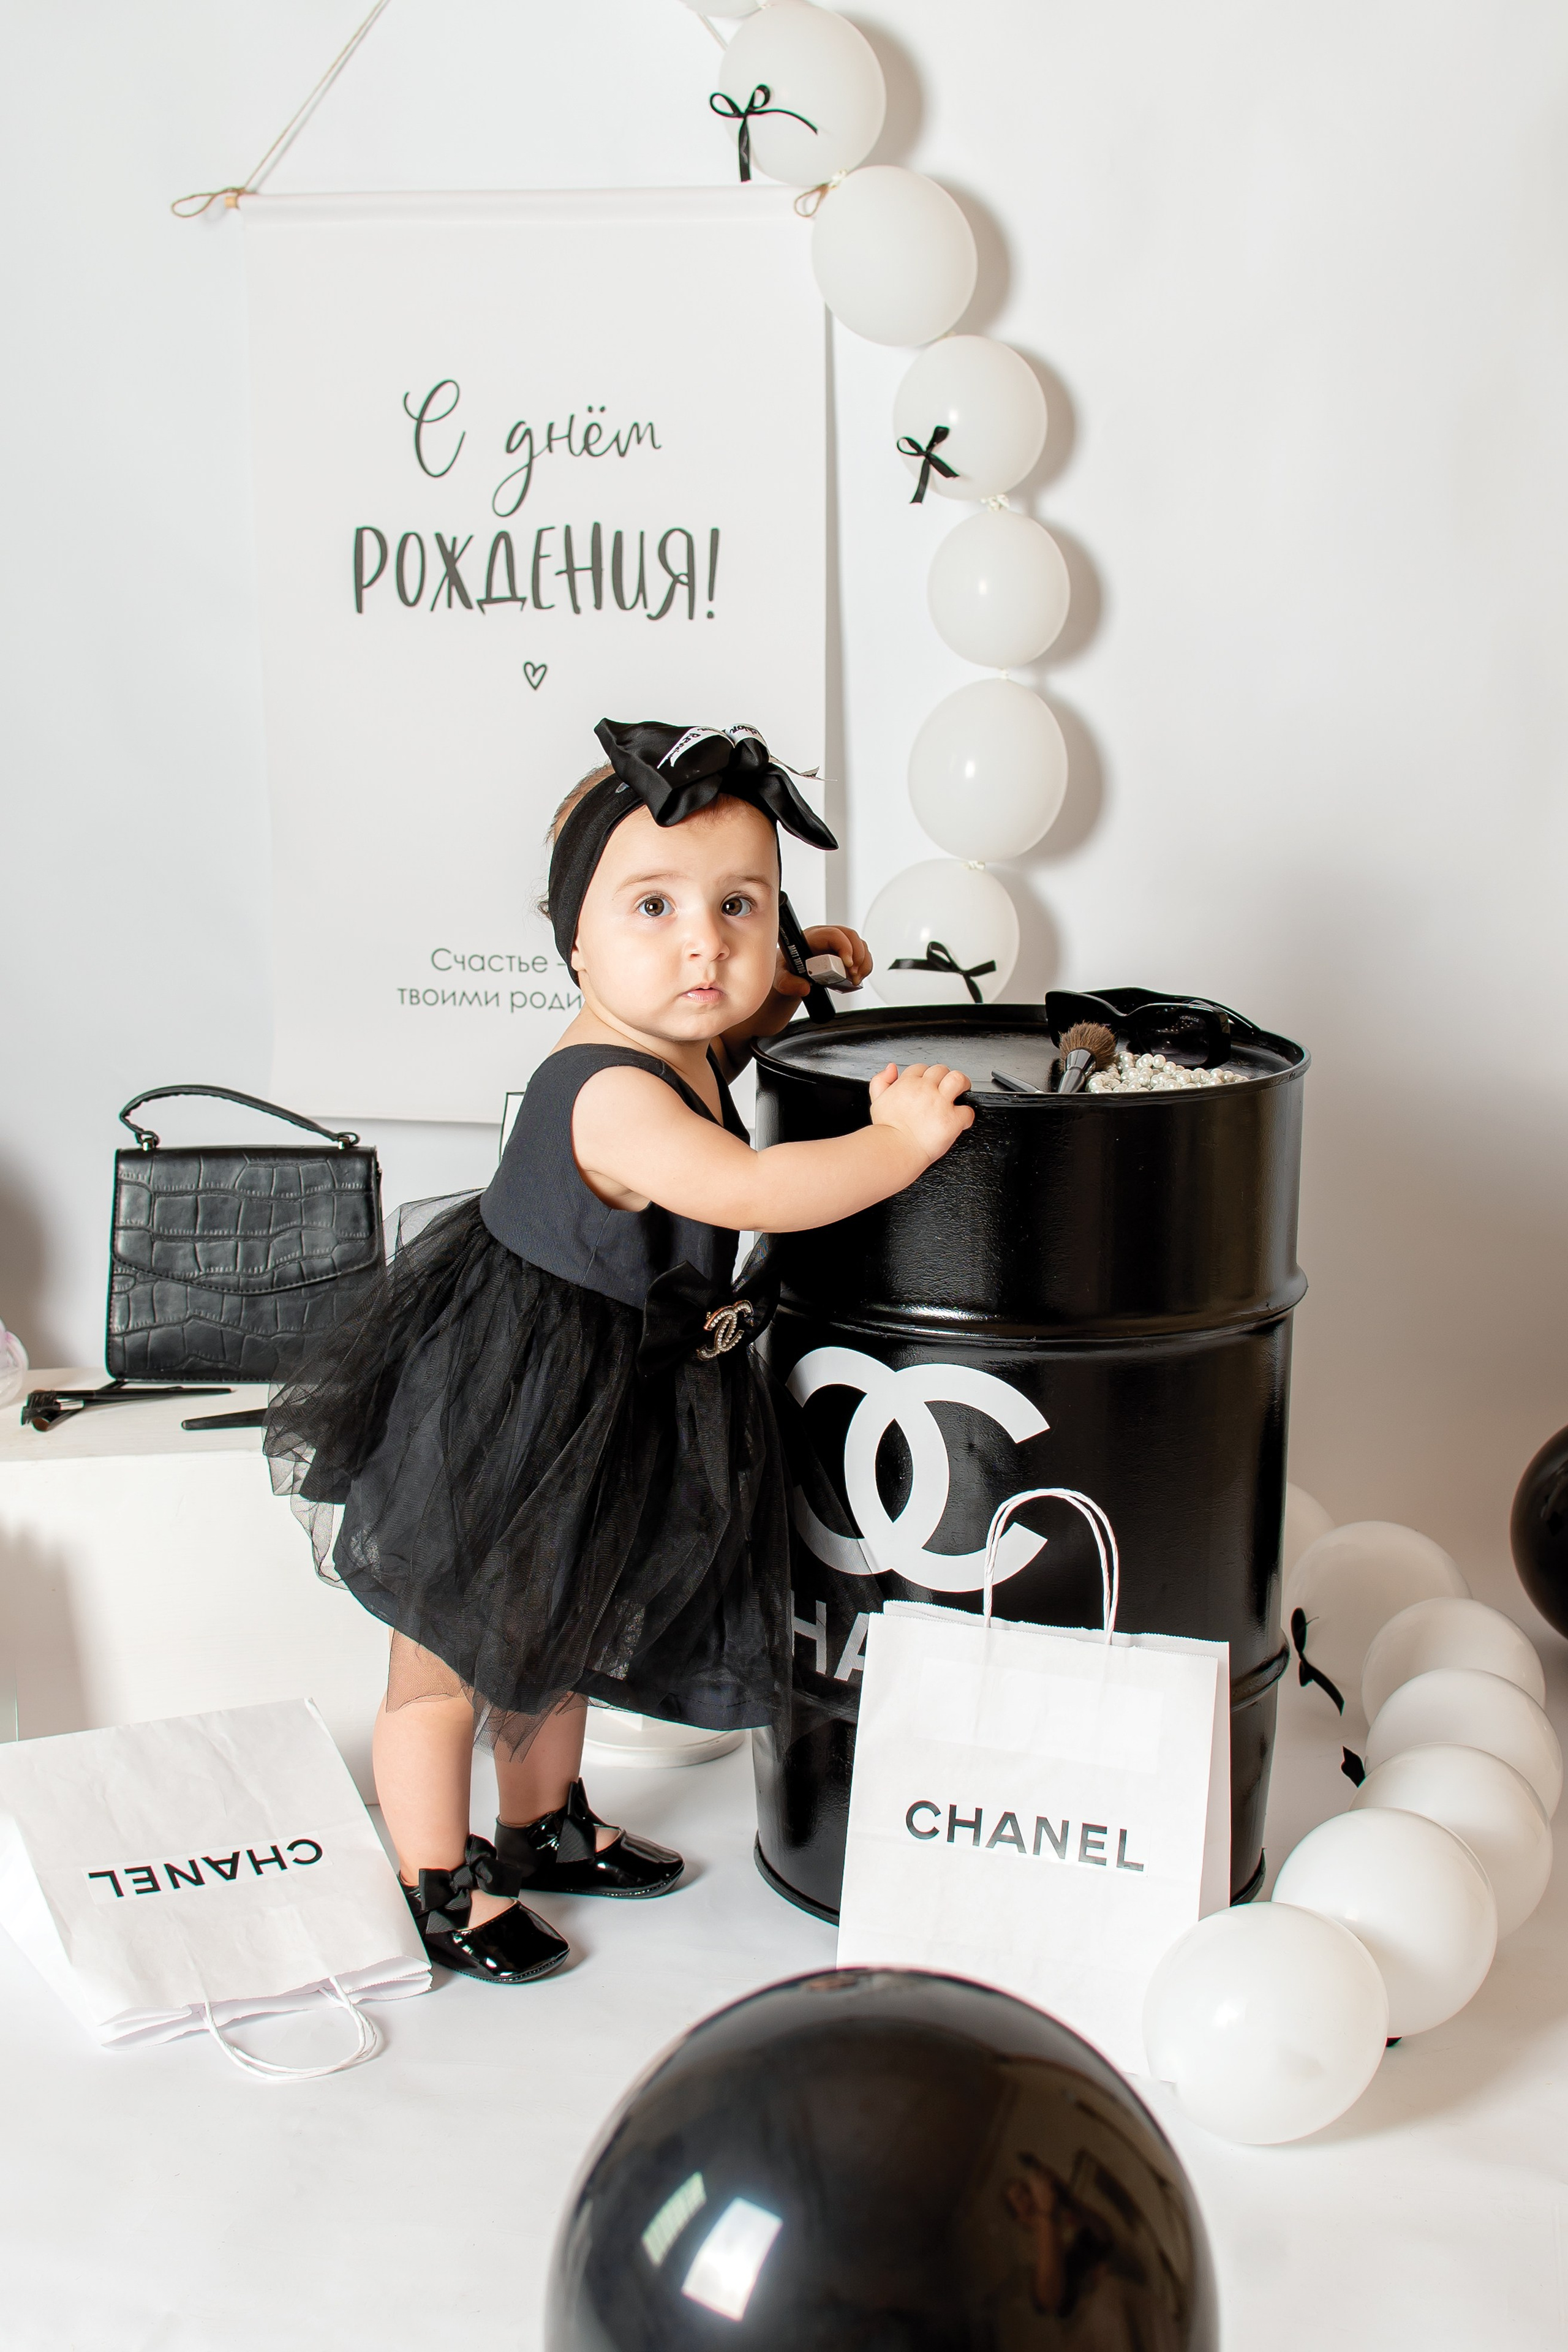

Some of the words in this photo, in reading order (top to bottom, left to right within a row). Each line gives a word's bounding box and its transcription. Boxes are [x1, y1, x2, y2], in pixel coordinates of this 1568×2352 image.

[403, 379, 466, 478] С
[492, 405, 662, 518] днём
[353, 522, 720, 620] РОЖДЕНИЯ!
[431, 948, 548, 973] Счастье
[397, 988, 500, 1008] твоими
[88, 1839, 323, 1898] CHANEL
[905, 1800, 1144, 1872] CHANEL
